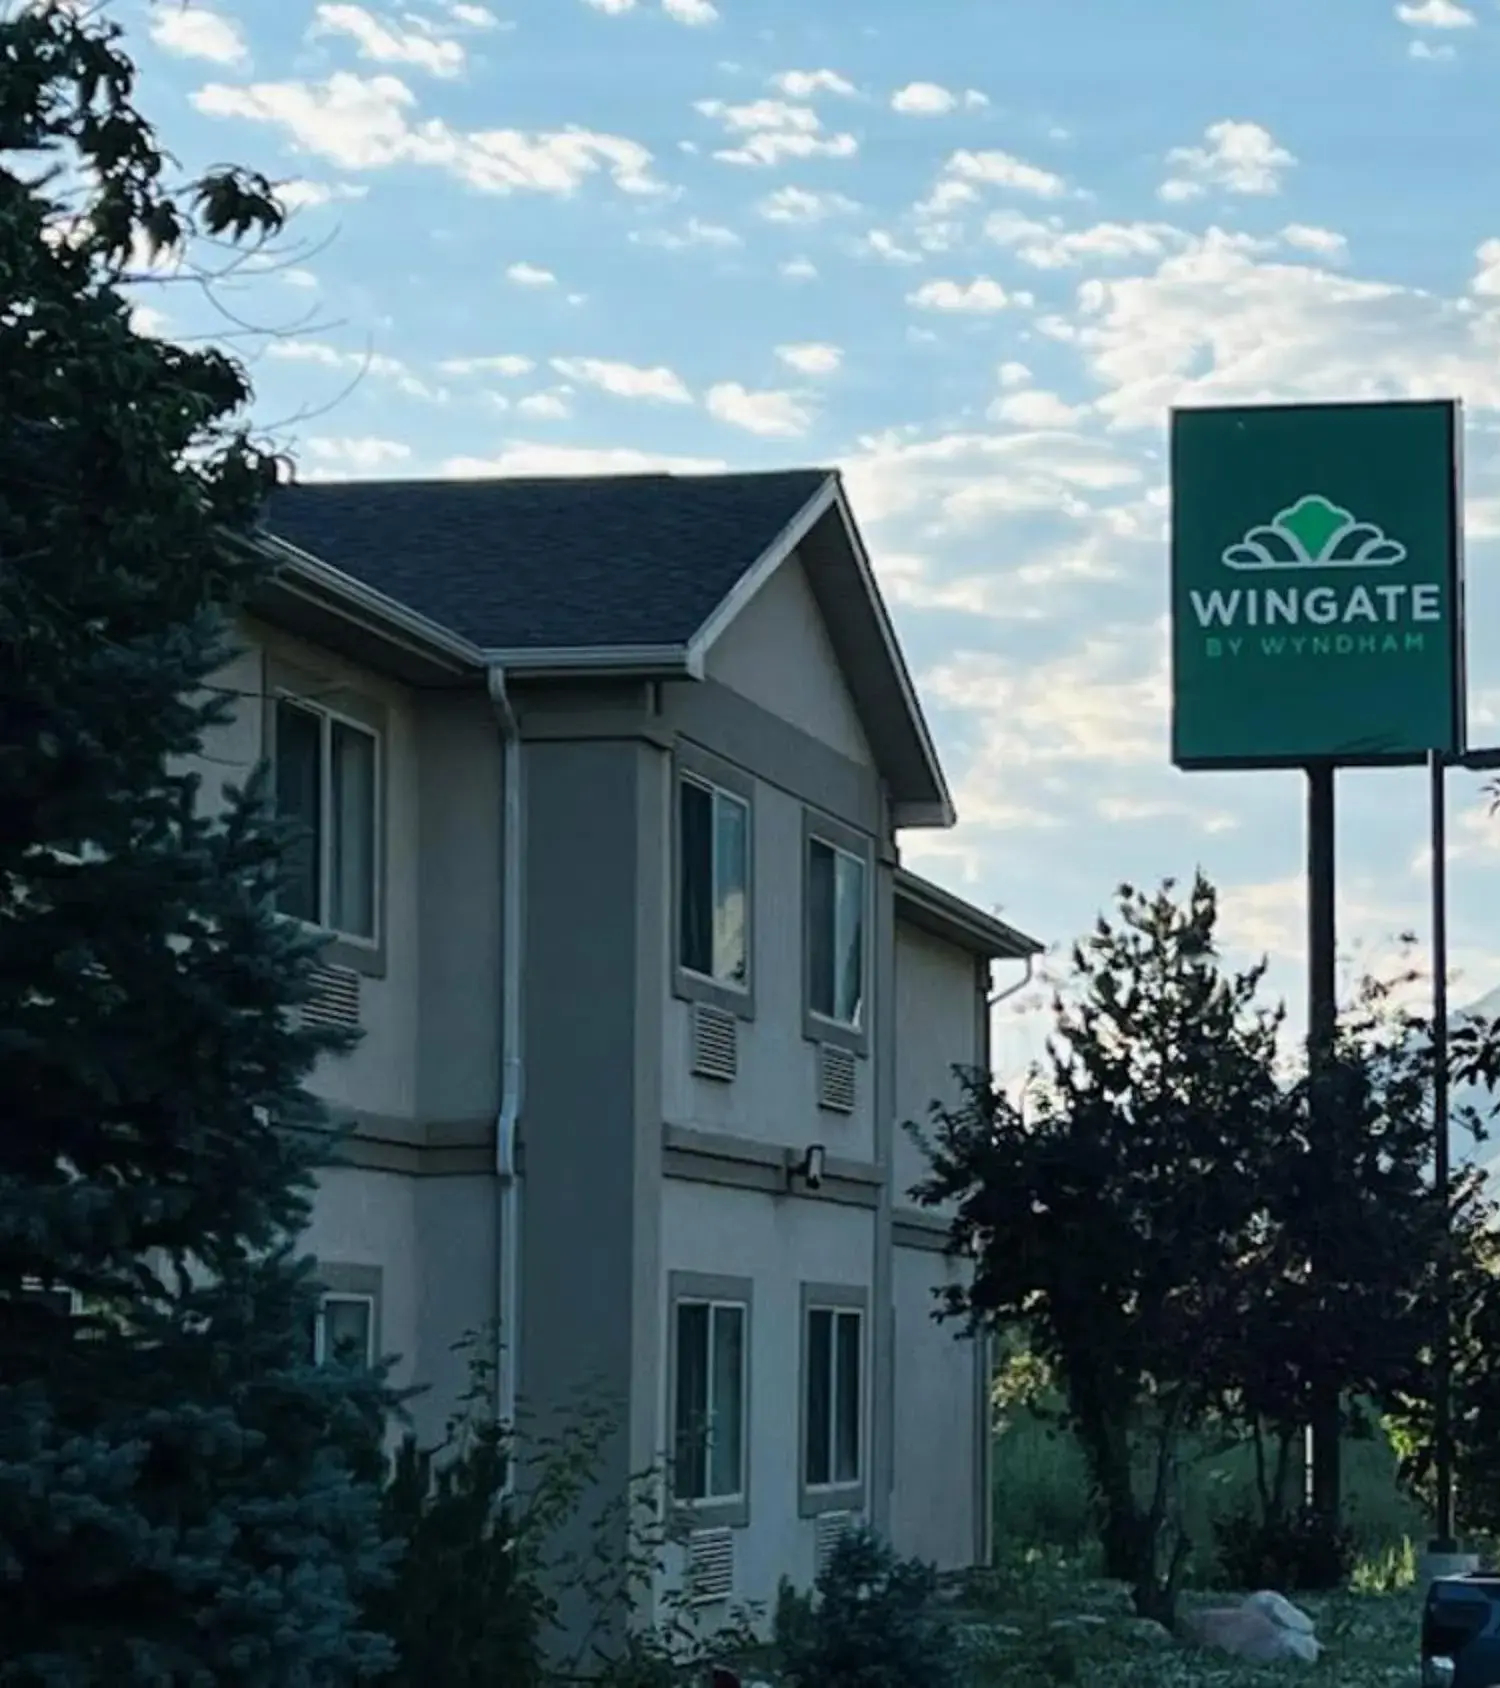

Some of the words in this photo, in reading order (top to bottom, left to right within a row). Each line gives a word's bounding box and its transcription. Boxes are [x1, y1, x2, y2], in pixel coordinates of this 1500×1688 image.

[1190, 584, 1441, 627] WINGATE
[1205, 637, 1243, 657] BY
[1261, 633, 1424, 656] WYNDHAM
